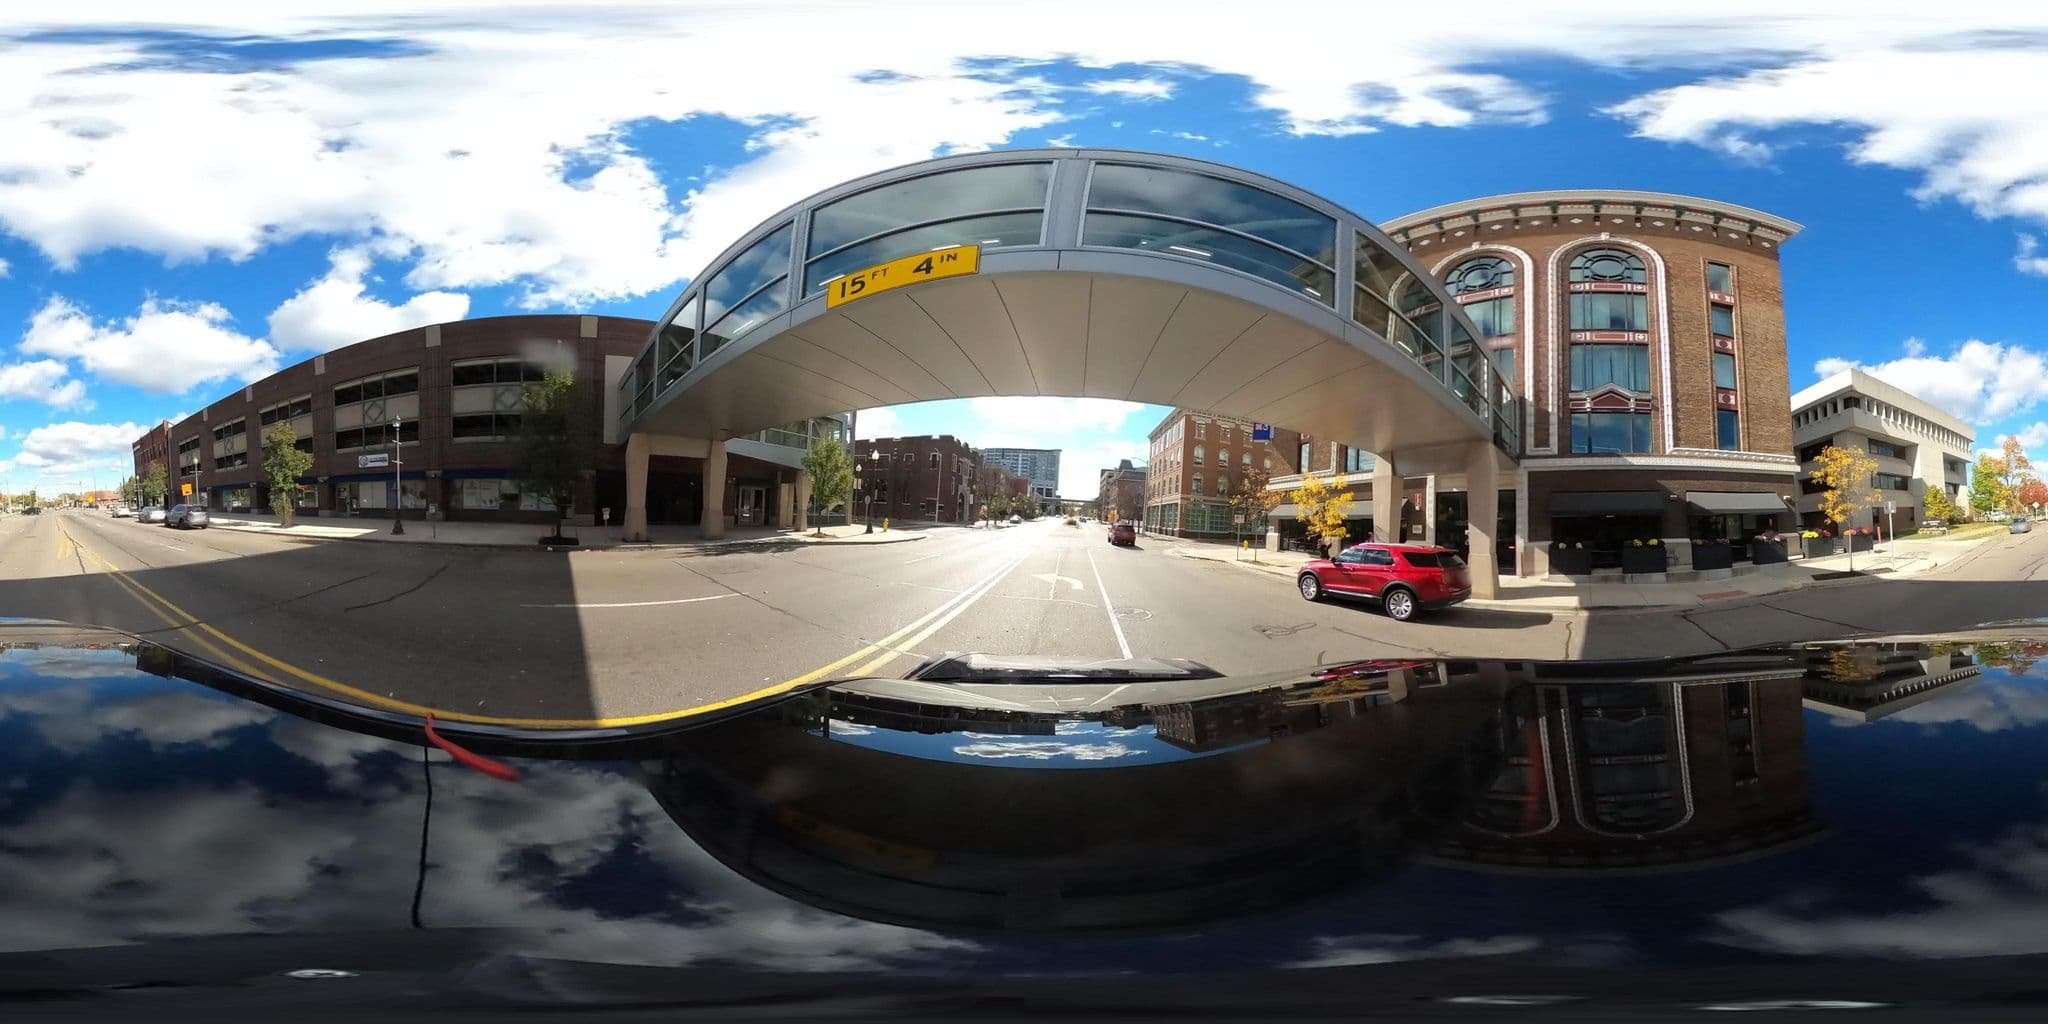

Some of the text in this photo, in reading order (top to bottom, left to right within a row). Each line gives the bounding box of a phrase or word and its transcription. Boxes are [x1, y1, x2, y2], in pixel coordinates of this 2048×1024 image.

[840, 252, 957, 298] 15 FT 4 IN
